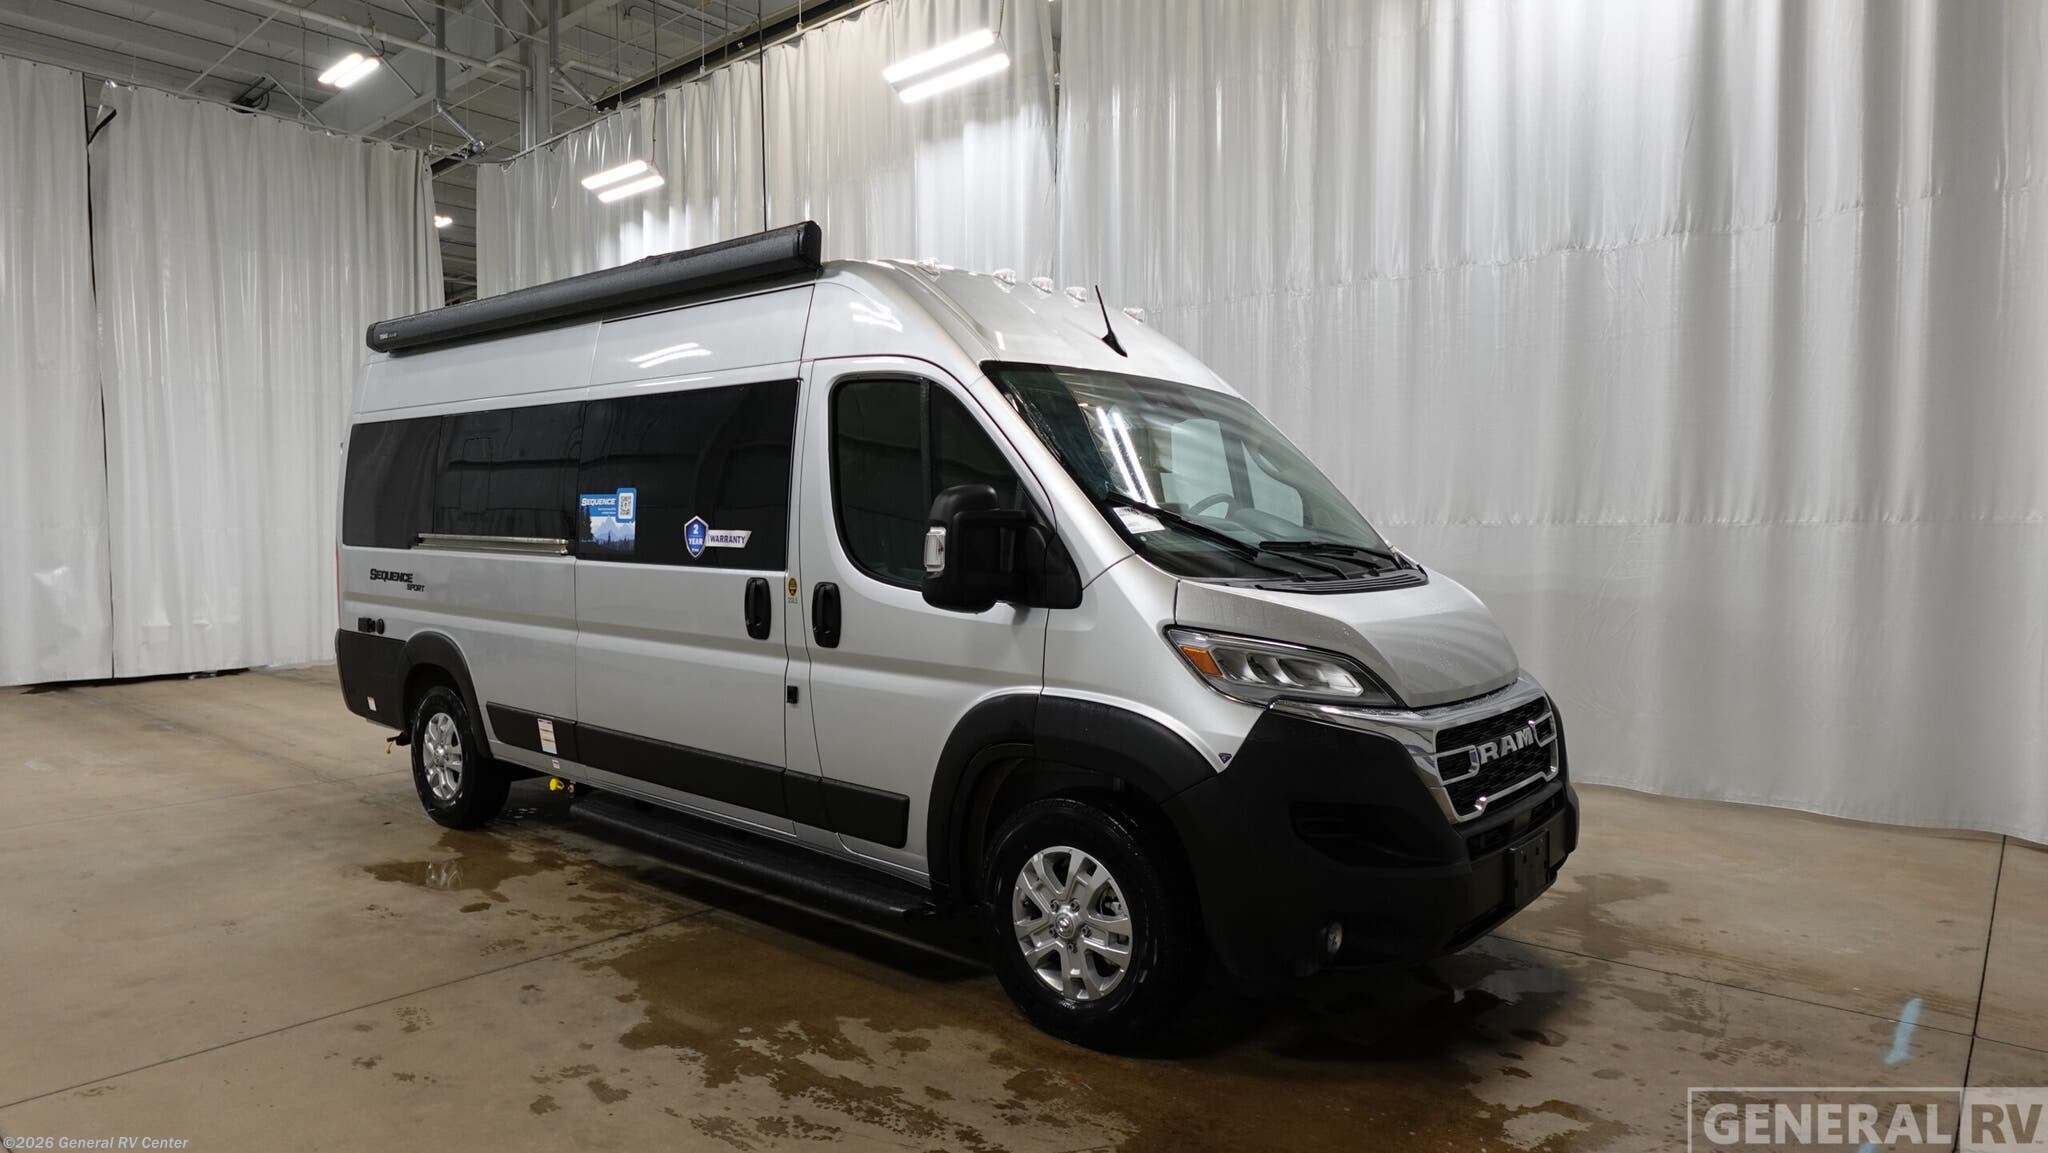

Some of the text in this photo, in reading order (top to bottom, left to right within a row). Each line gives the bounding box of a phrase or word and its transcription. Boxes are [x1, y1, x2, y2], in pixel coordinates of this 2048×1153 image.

[581, 498, 617, 506] SEQUENCE
[693, 523, 699, 535] 2
[688, 537, 703, 545] YEAR
[710, 535, 746, 545] WARRANTY
[369, 568, 413, 584] SEQUENCE
[406, 583, 425, 592] SPORT
[1478, 727, 1534, 764] RAM
